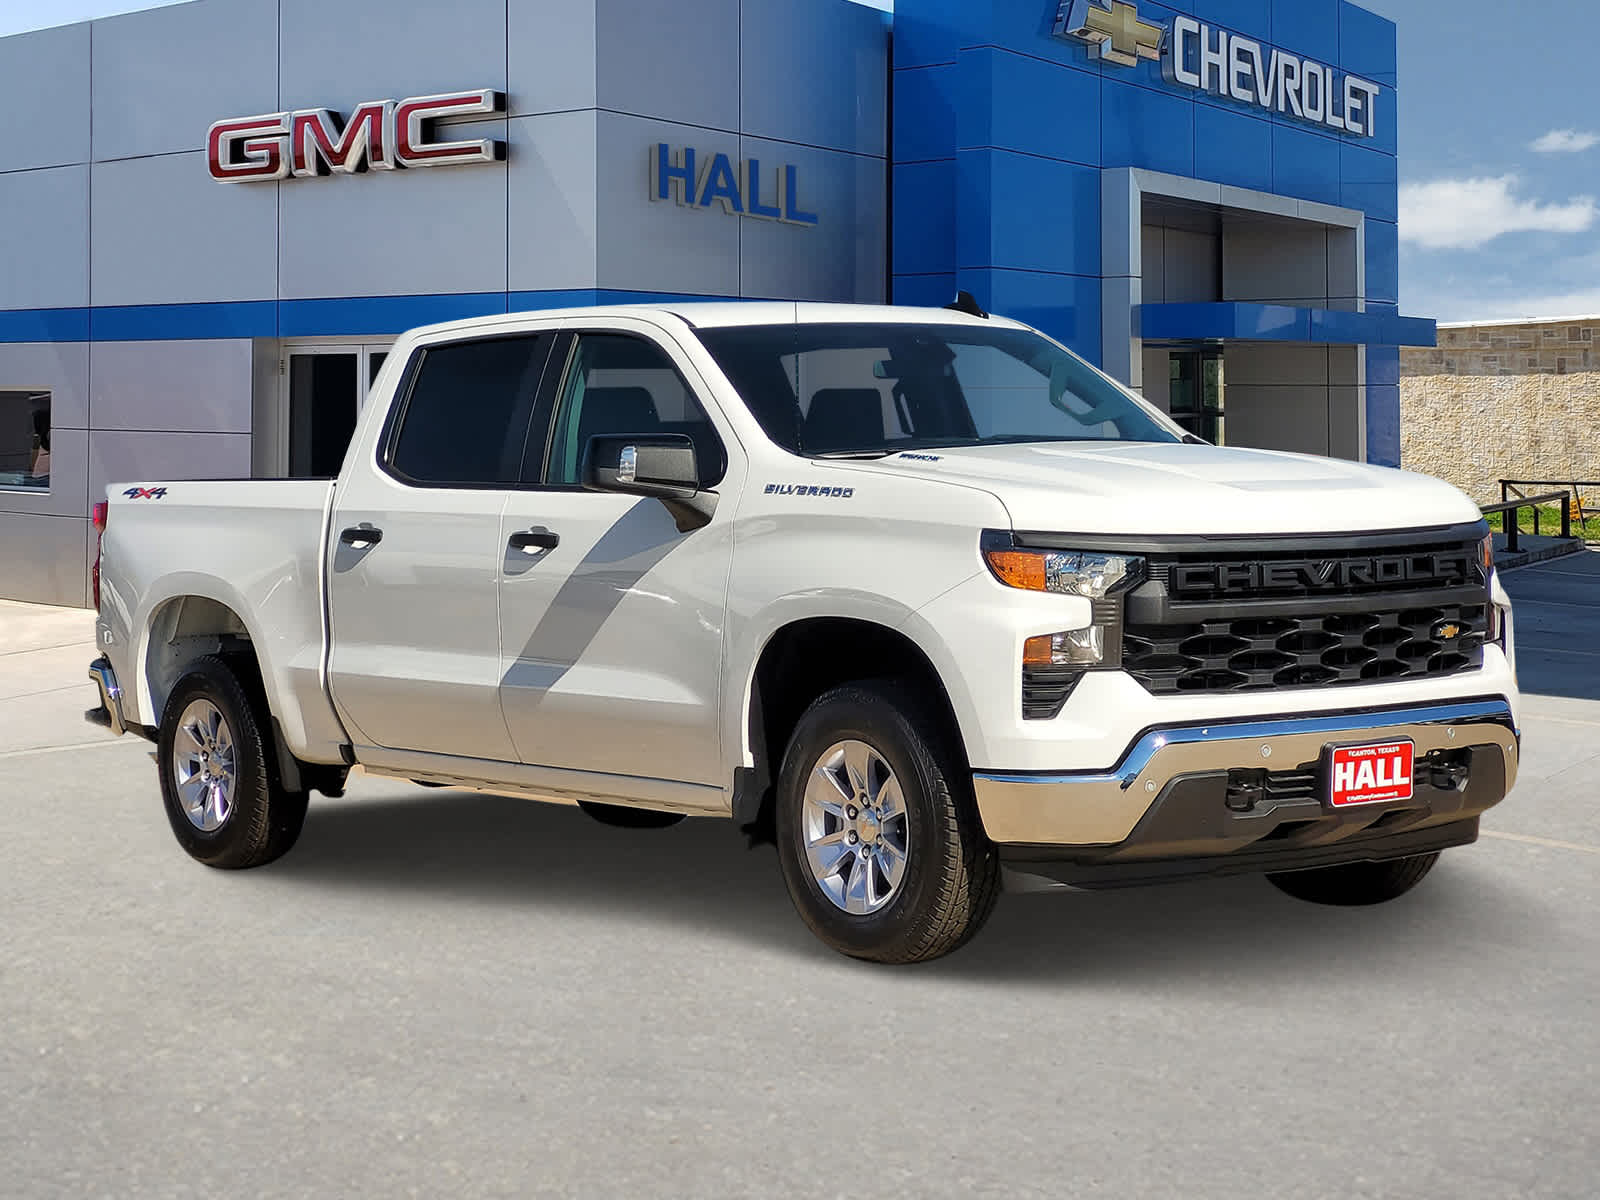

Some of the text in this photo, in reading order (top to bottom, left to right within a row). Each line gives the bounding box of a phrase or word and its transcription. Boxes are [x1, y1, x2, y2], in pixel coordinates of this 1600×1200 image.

[1173, 15, 1380, 137] CHEVROLET
[208, 88, 506, 184] GMC
[650, 142, 818, 228] HALL
[764, 484, 854, 498] SILVERADO
[1334, 757, 1409, 792] HALL
